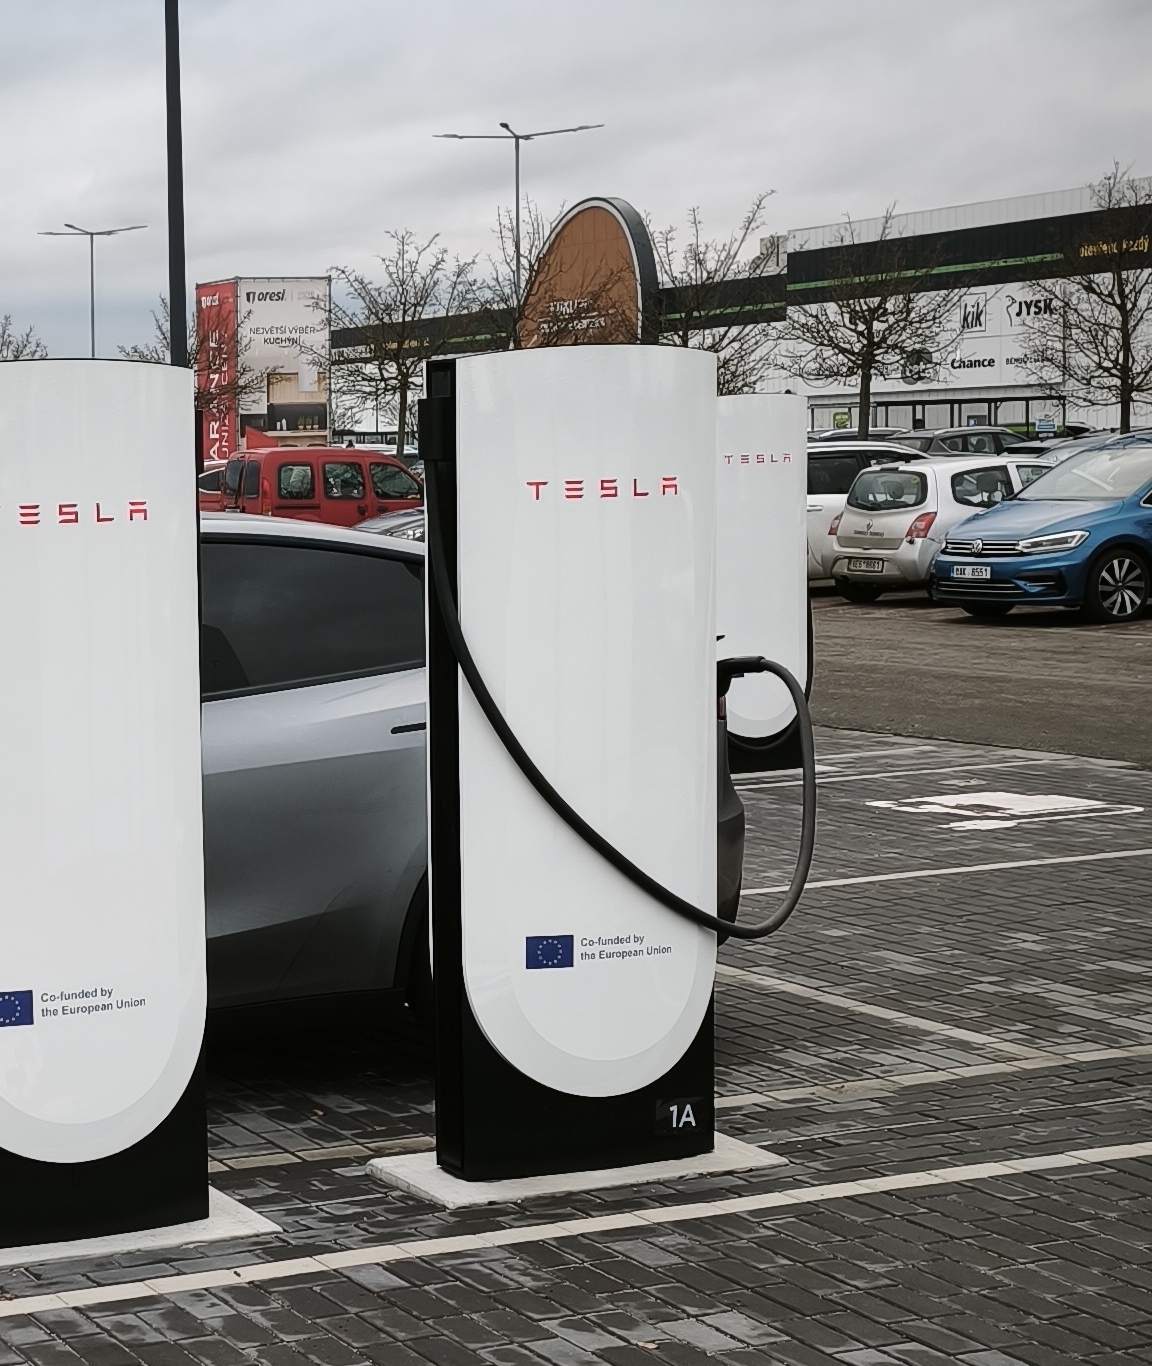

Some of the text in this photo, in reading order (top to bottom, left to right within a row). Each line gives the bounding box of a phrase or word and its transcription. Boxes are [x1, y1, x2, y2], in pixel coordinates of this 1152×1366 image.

[962, 301, 984, 329] kik
[1015, 298, 1054, 317] JYSK
[950, 357, 996, 370] Chance
[723, 453, 791, 465] TESLA
[526, 476, 678, 501] TESLA
[581, 934, 645, 947] Co-funded by
[580, 945, 672, 961] the European Union
[40, 987, 114, 1003] Co-funded by
[41, 997, 146, 1017] the European Union
[669, 1103, 696, 1128] 1A
